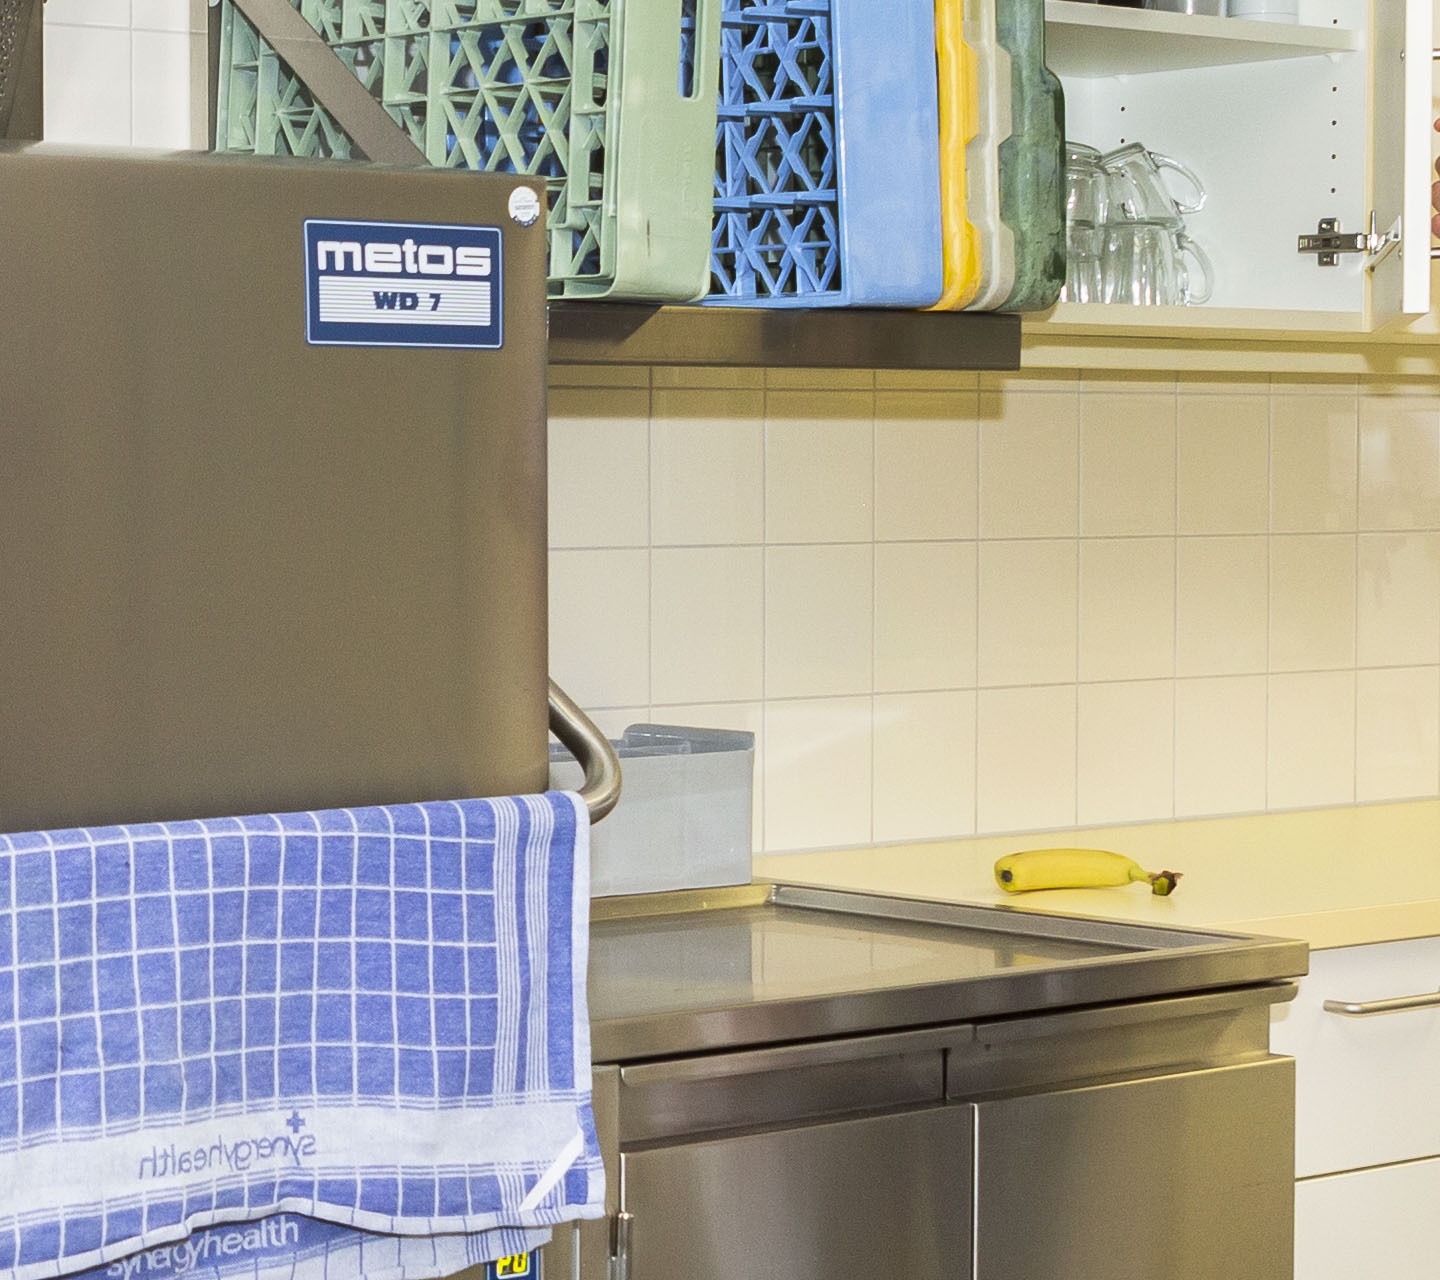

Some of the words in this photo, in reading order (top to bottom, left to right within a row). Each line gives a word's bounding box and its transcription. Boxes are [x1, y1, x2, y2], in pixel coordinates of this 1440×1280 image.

[316, 238, 492, 277] metos
[372, 290, 420, 311] WD
[429, 293, 442, 312] 7
